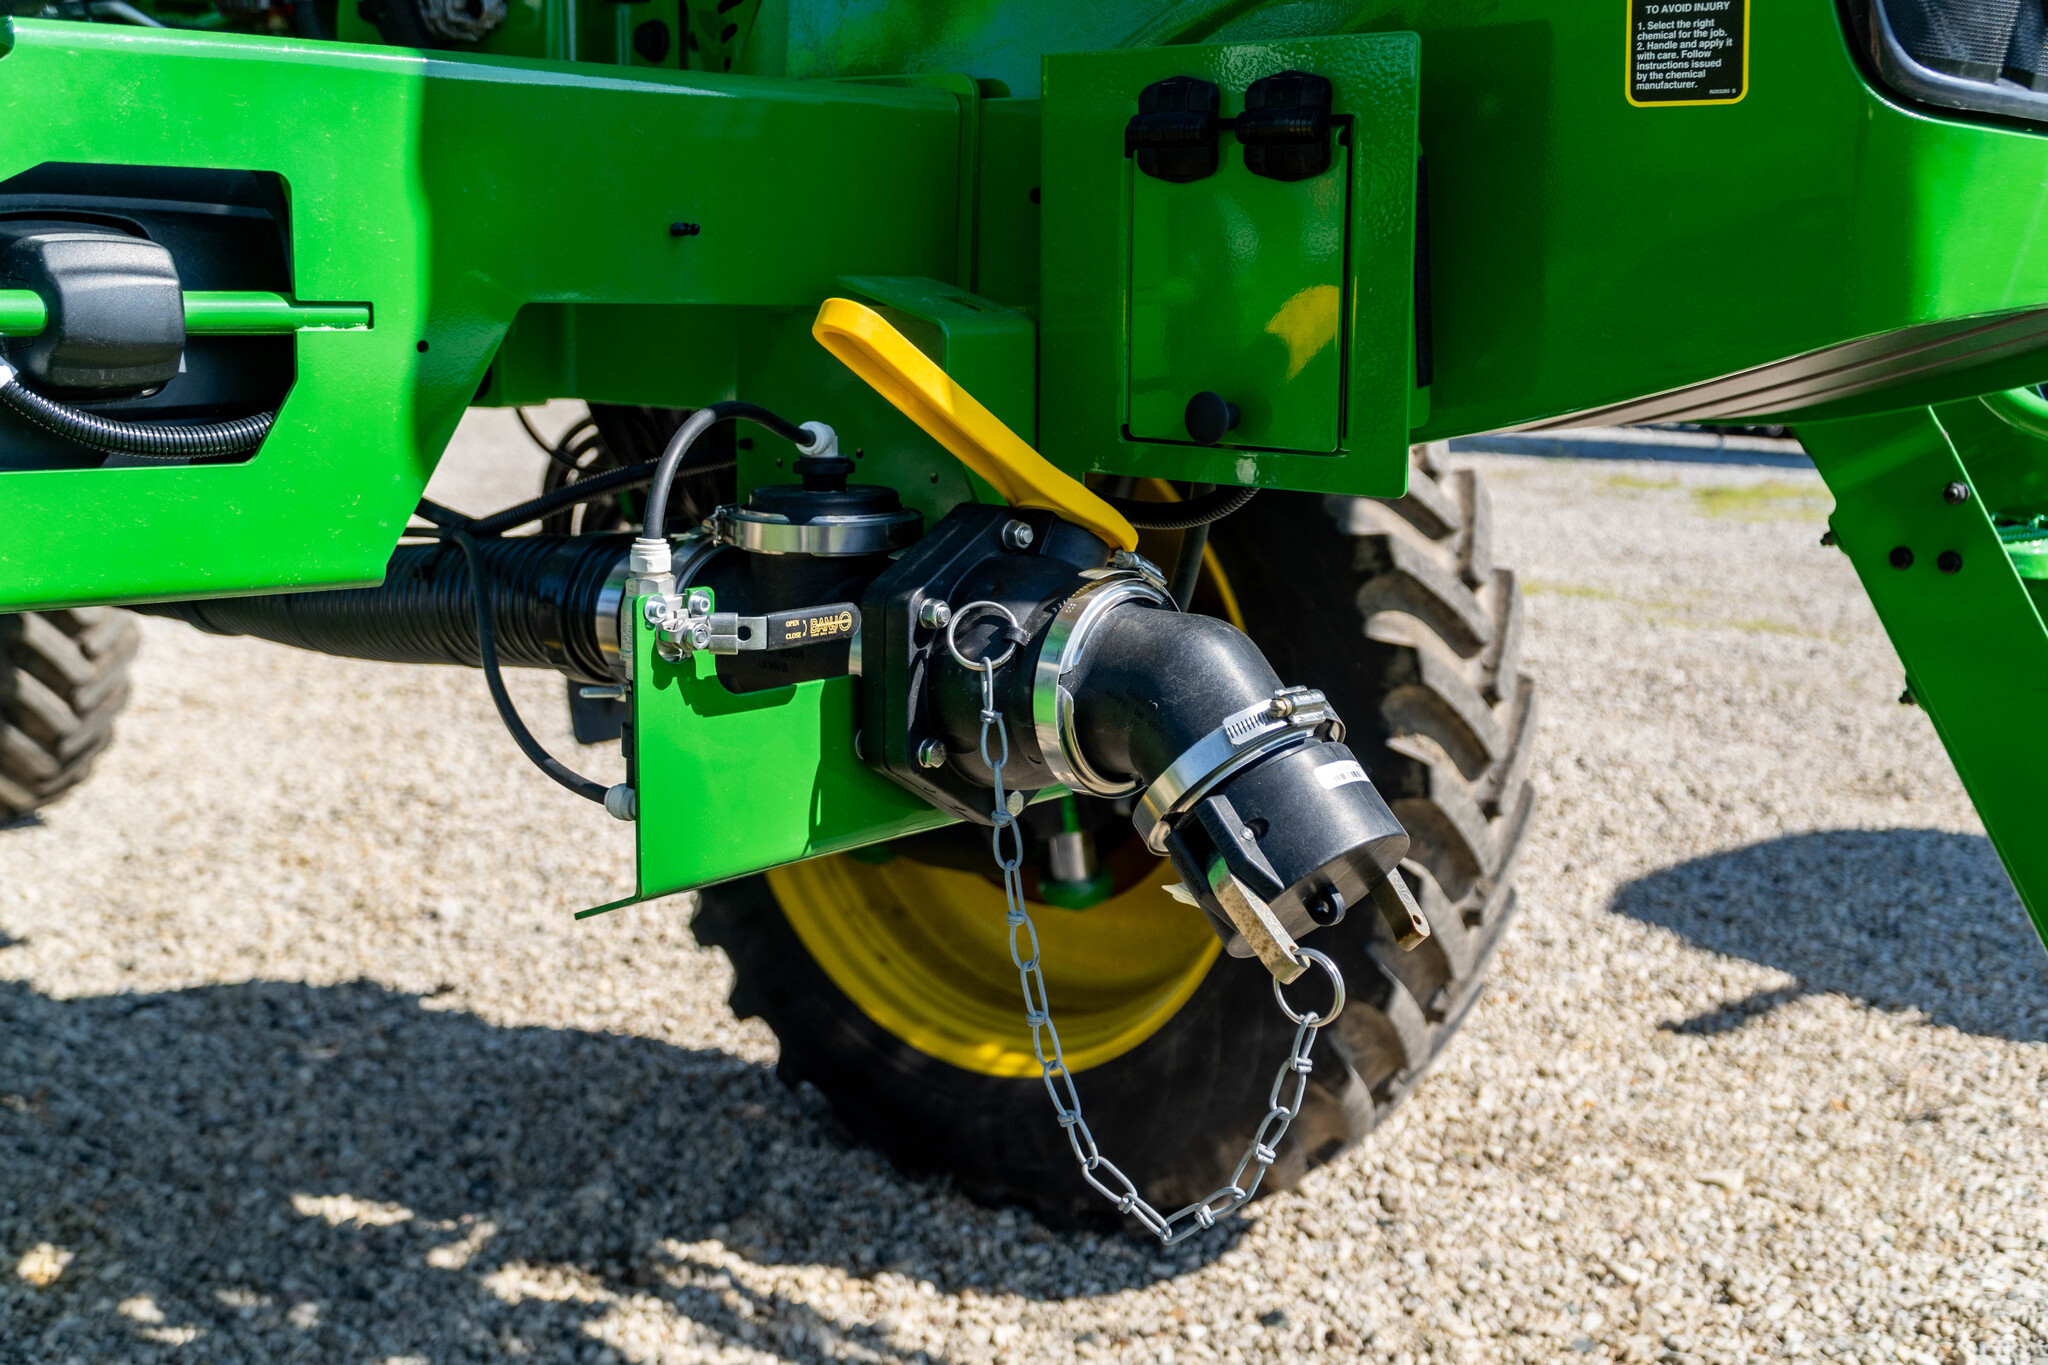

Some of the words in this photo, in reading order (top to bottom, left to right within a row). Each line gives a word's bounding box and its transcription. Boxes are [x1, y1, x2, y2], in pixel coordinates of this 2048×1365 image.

[1645, 5, 1659, 14] TO
[1661, 3, 1692, 13] AVOID
[1694, 1, 1731, 12] INJURY
[1637, 22, 1645, 30] 1.
[1647, 20, 1675, 30] Select
[1677, 20, 1691, 28] the
[1693, 18, 1715, 29] right
[1636, 31, 1676, 40] chemical
[1678, 30, 1691, 38] for
[1693, 29, 1708, 38] the
[1710, 28, 1727, 39] job.
[1636, 42, 1645, 50] 2.
[1647, 40, 1678, 50] Handle
[1680, 39, 1697, 49] and
[1699, 39, 1724, 50] apply
[1725, 38, 1733, 47] it
[1636, 51, 1655, 60] with
[1657, 51, 1679, 60] care.
[1681, 49, 1711, 59] Follow
[1636, 60, 1689, 70] instructions
[1691, 58, 1722, 68] issued
[1636, 71, 1648, 82] by
[1649, 70, 1663, 80] the
[1665, 69, 1706, 79] chemical
[1636, 80, 1698, 90] manufacturer.
[785, 619, 800, 628] OPEN
[810, 611, 853, 634] BANJO
[785, 631, 802, 640] CLOSE
[1200, 806, 1240, 862] BANJO
